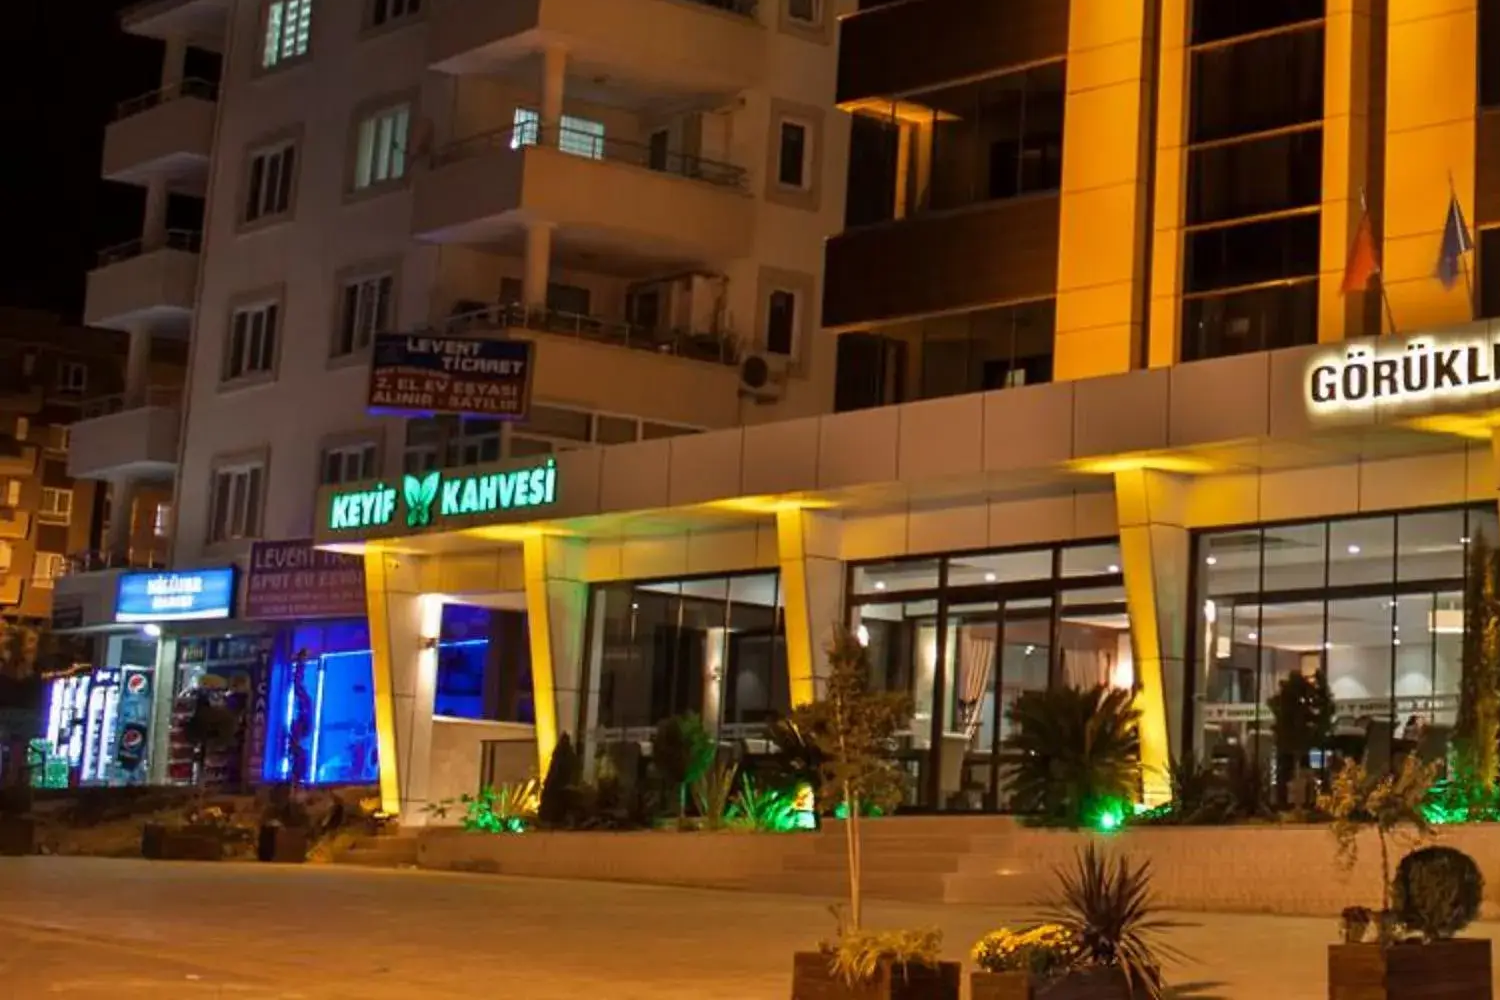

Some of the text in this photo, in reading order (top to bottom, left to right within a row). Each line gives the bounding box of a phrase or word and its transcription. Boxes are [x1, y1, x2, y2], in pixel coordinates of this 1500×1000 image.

[406, 336, 483, 355] LEVENT
[331, 458, 556, 529] KEYİF KAHVESİ
